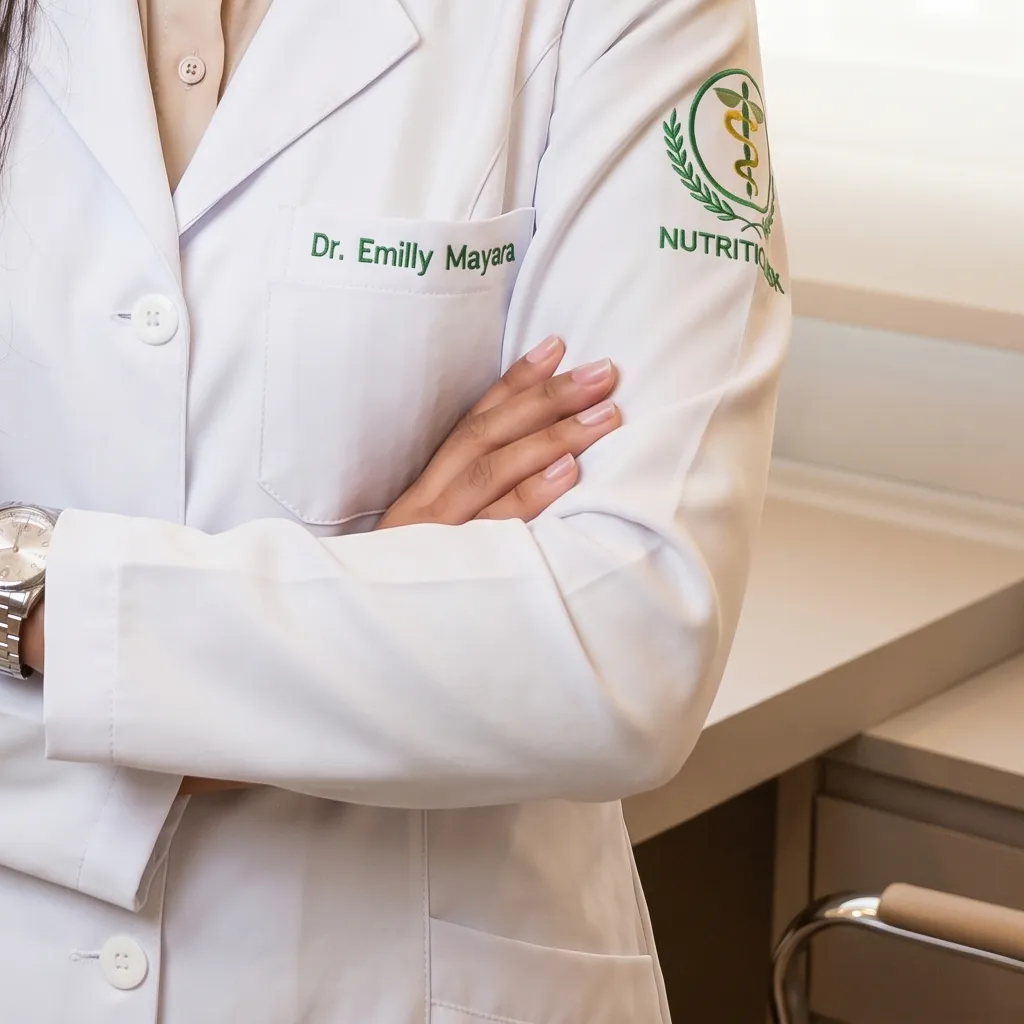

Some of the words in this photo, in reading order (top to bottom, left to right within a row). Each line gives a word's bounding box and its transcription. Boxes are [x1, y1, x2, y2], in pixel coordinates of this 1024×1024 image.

[311, 232, 344, 261] Dr.
[358, 237, 434, 276] Emilly
[445, 242, 516, 276] Mayara
